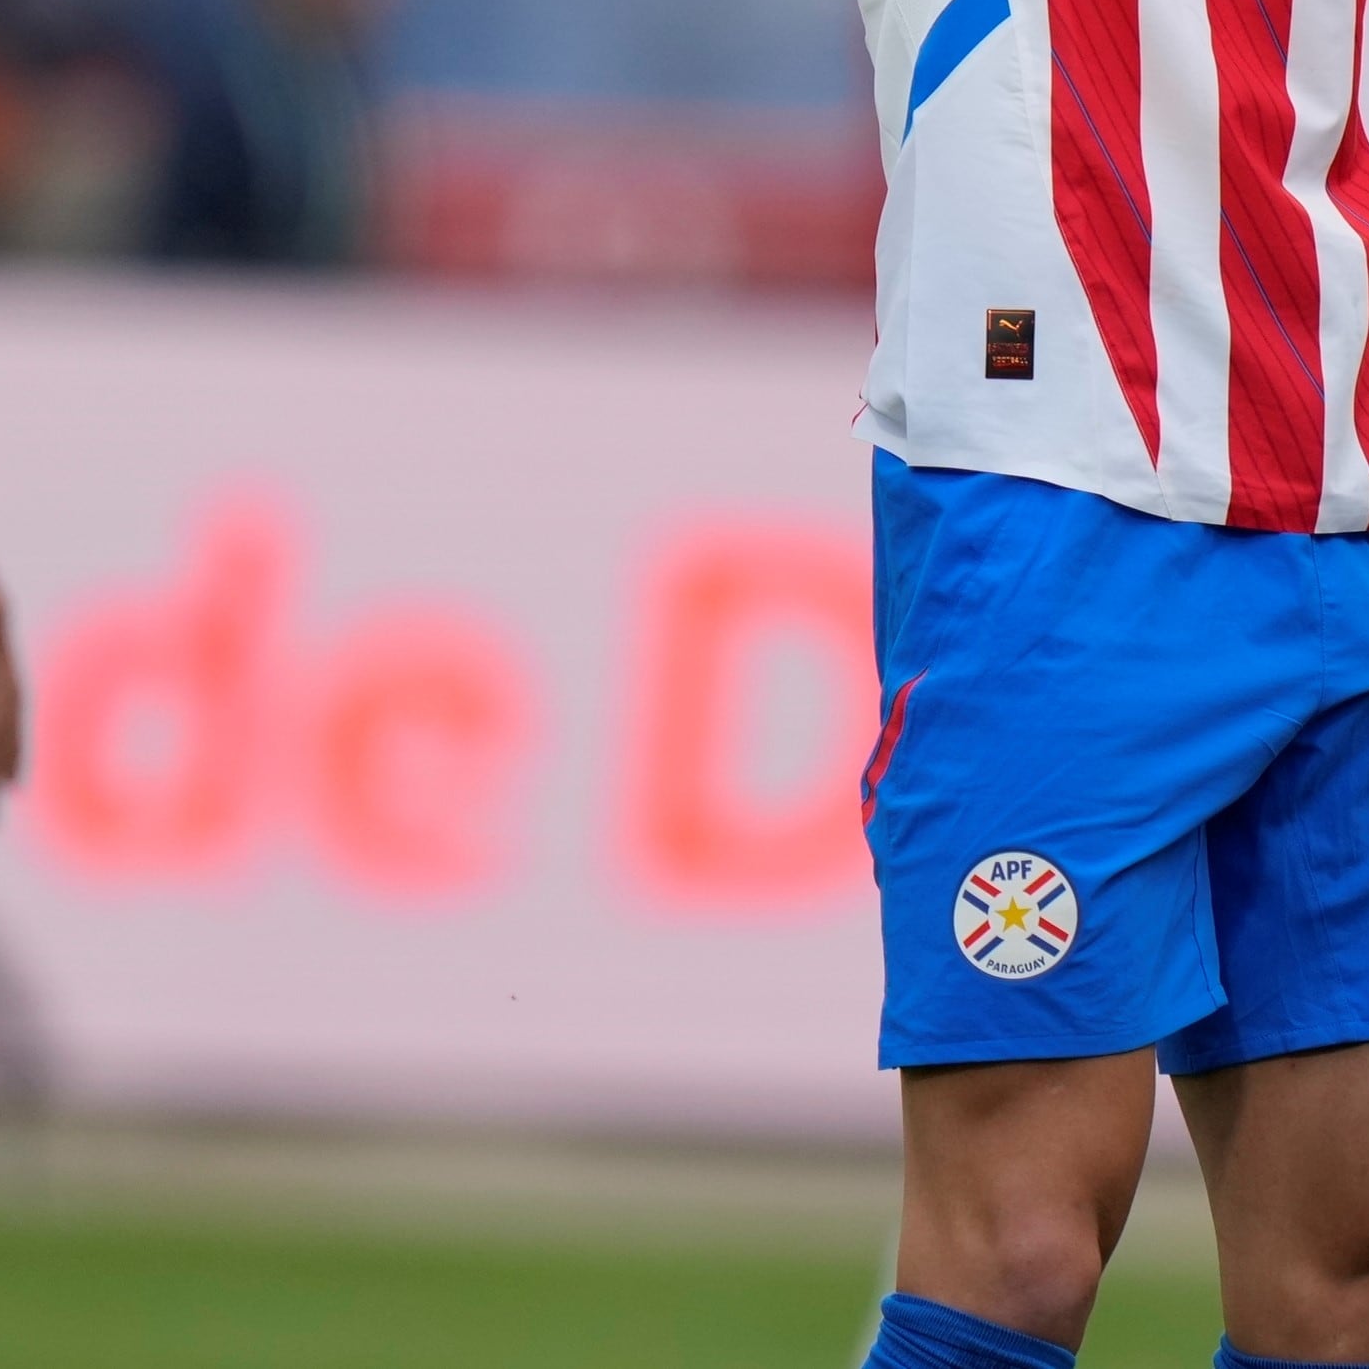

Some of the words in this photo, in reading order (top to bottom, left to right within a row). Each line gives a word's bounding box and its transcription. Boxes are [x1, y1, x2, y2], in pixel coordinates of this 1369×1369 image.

[41, 490, 521, 888] de
[990, 859, 1033, 882] APF
[986, 956, 1047, 975] PARAGUAY
